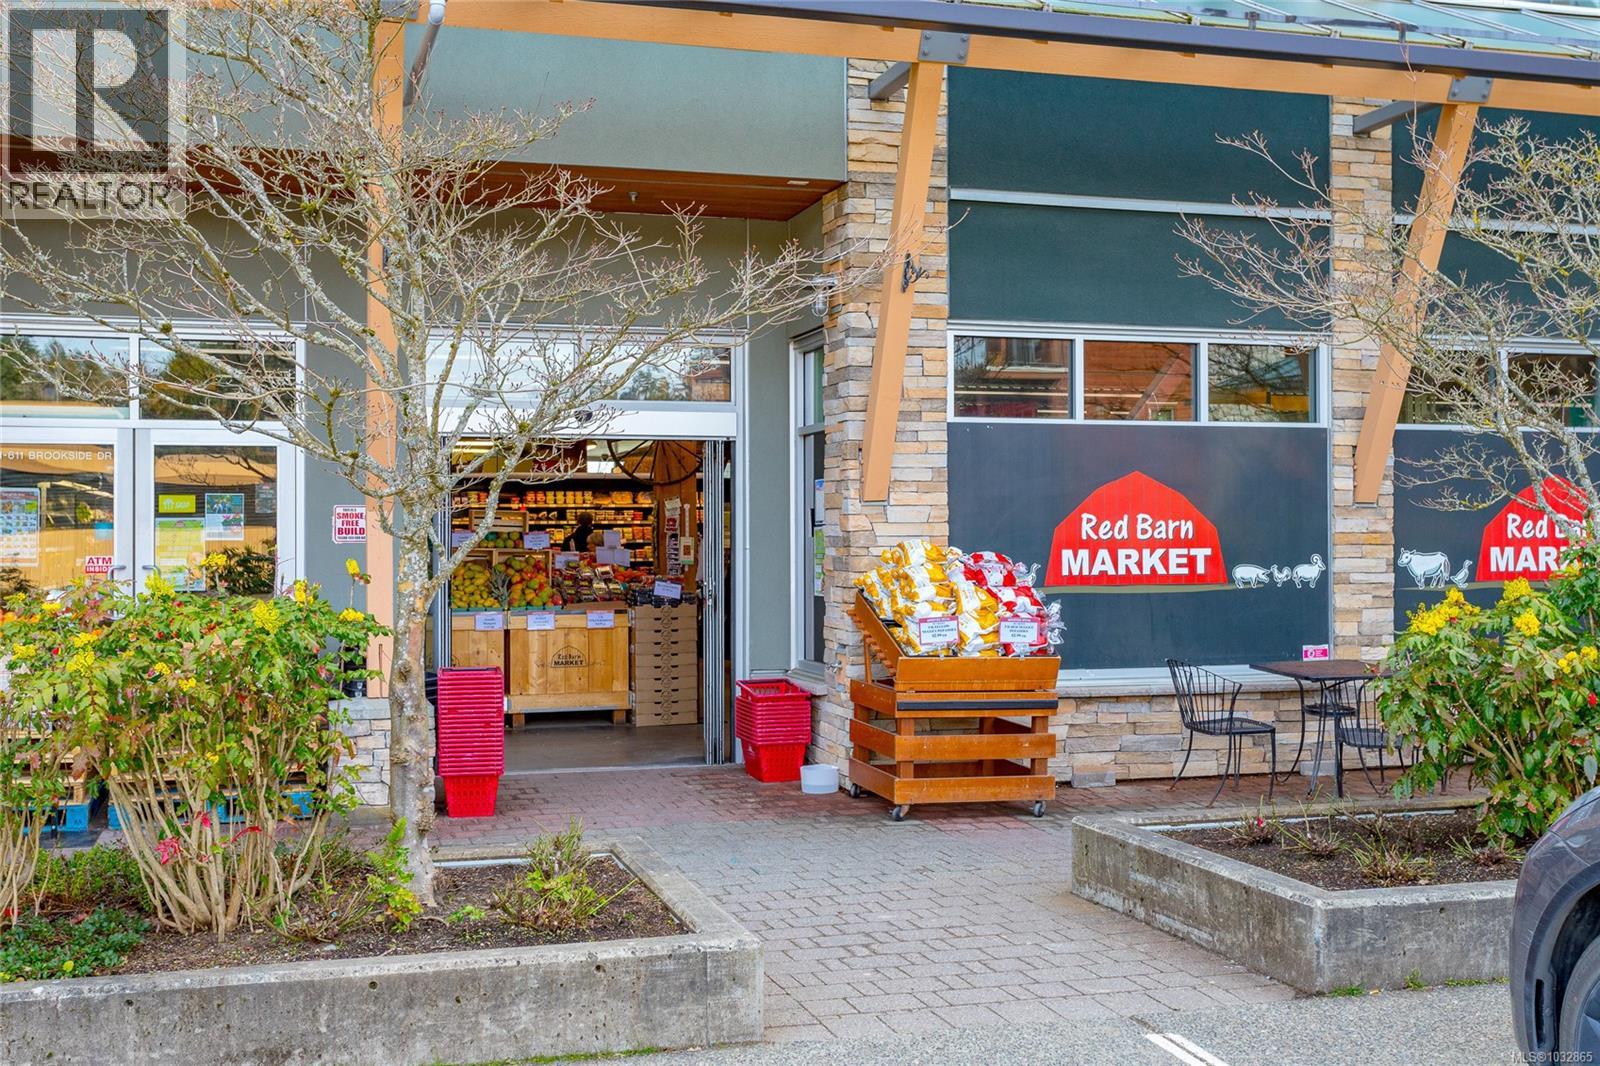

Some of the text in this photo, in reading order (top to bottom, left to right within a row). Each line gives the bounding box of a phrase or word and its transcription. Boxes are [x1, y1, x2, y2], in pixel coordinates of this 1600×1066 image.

[28, 451, 92, 460] BROOKSIDE
[97, 451, 113, 460] DR
[337, 527, 365, 535] BUILD
[1081, 512, 1194, 541] Red Barn
[1506, 512, 1549, 539] Red
[1061, 548, 1212, 577] MARKET
